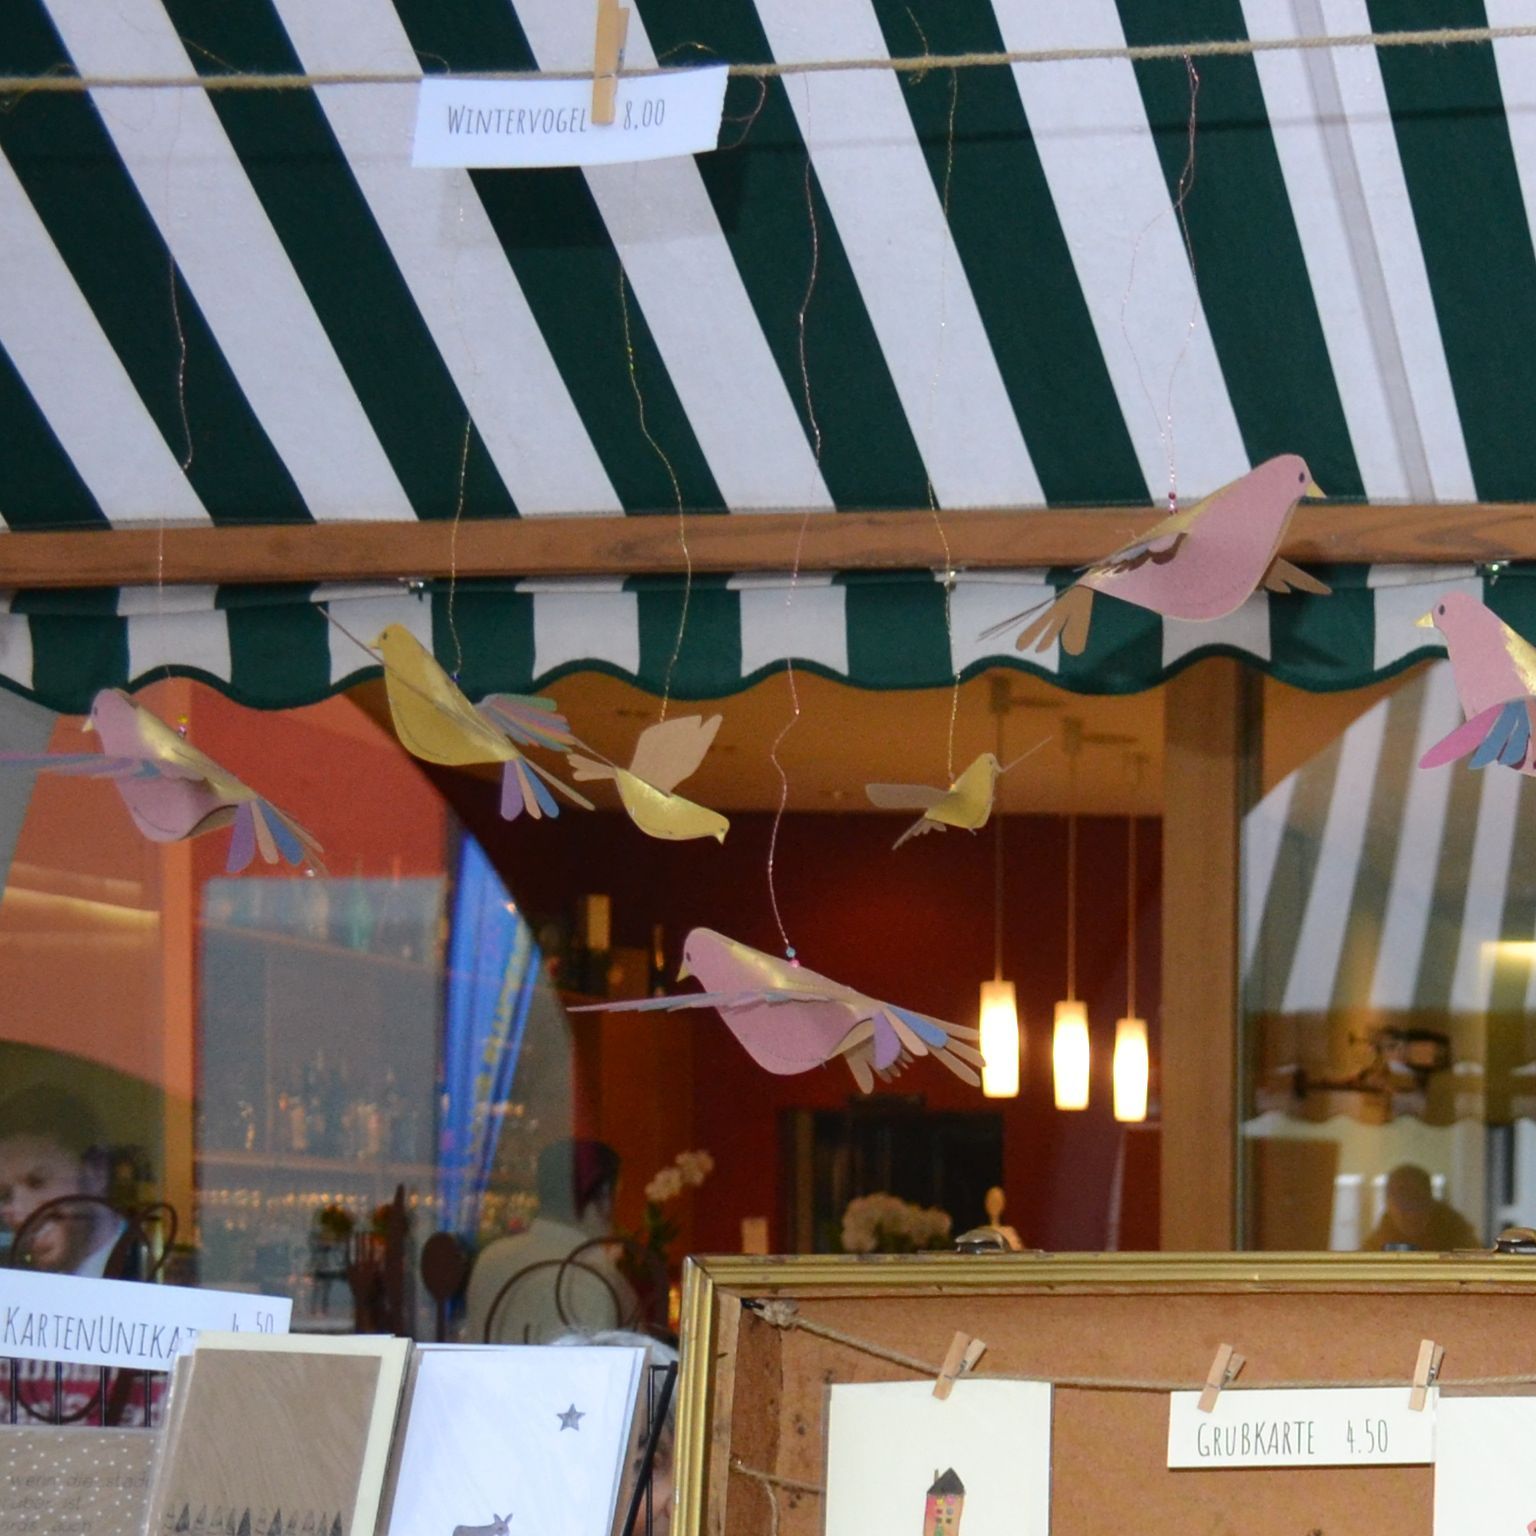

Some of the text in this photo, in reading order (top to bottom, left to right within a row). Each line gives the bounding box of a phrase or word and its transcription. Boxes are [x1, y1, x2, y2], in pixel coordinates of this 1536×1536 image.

[623, 98, 666, 131] 8.00
[4, 1306, 197, 1359] KARTENUNIKA
[1346, 1418, 1389, 1454] 4.50
